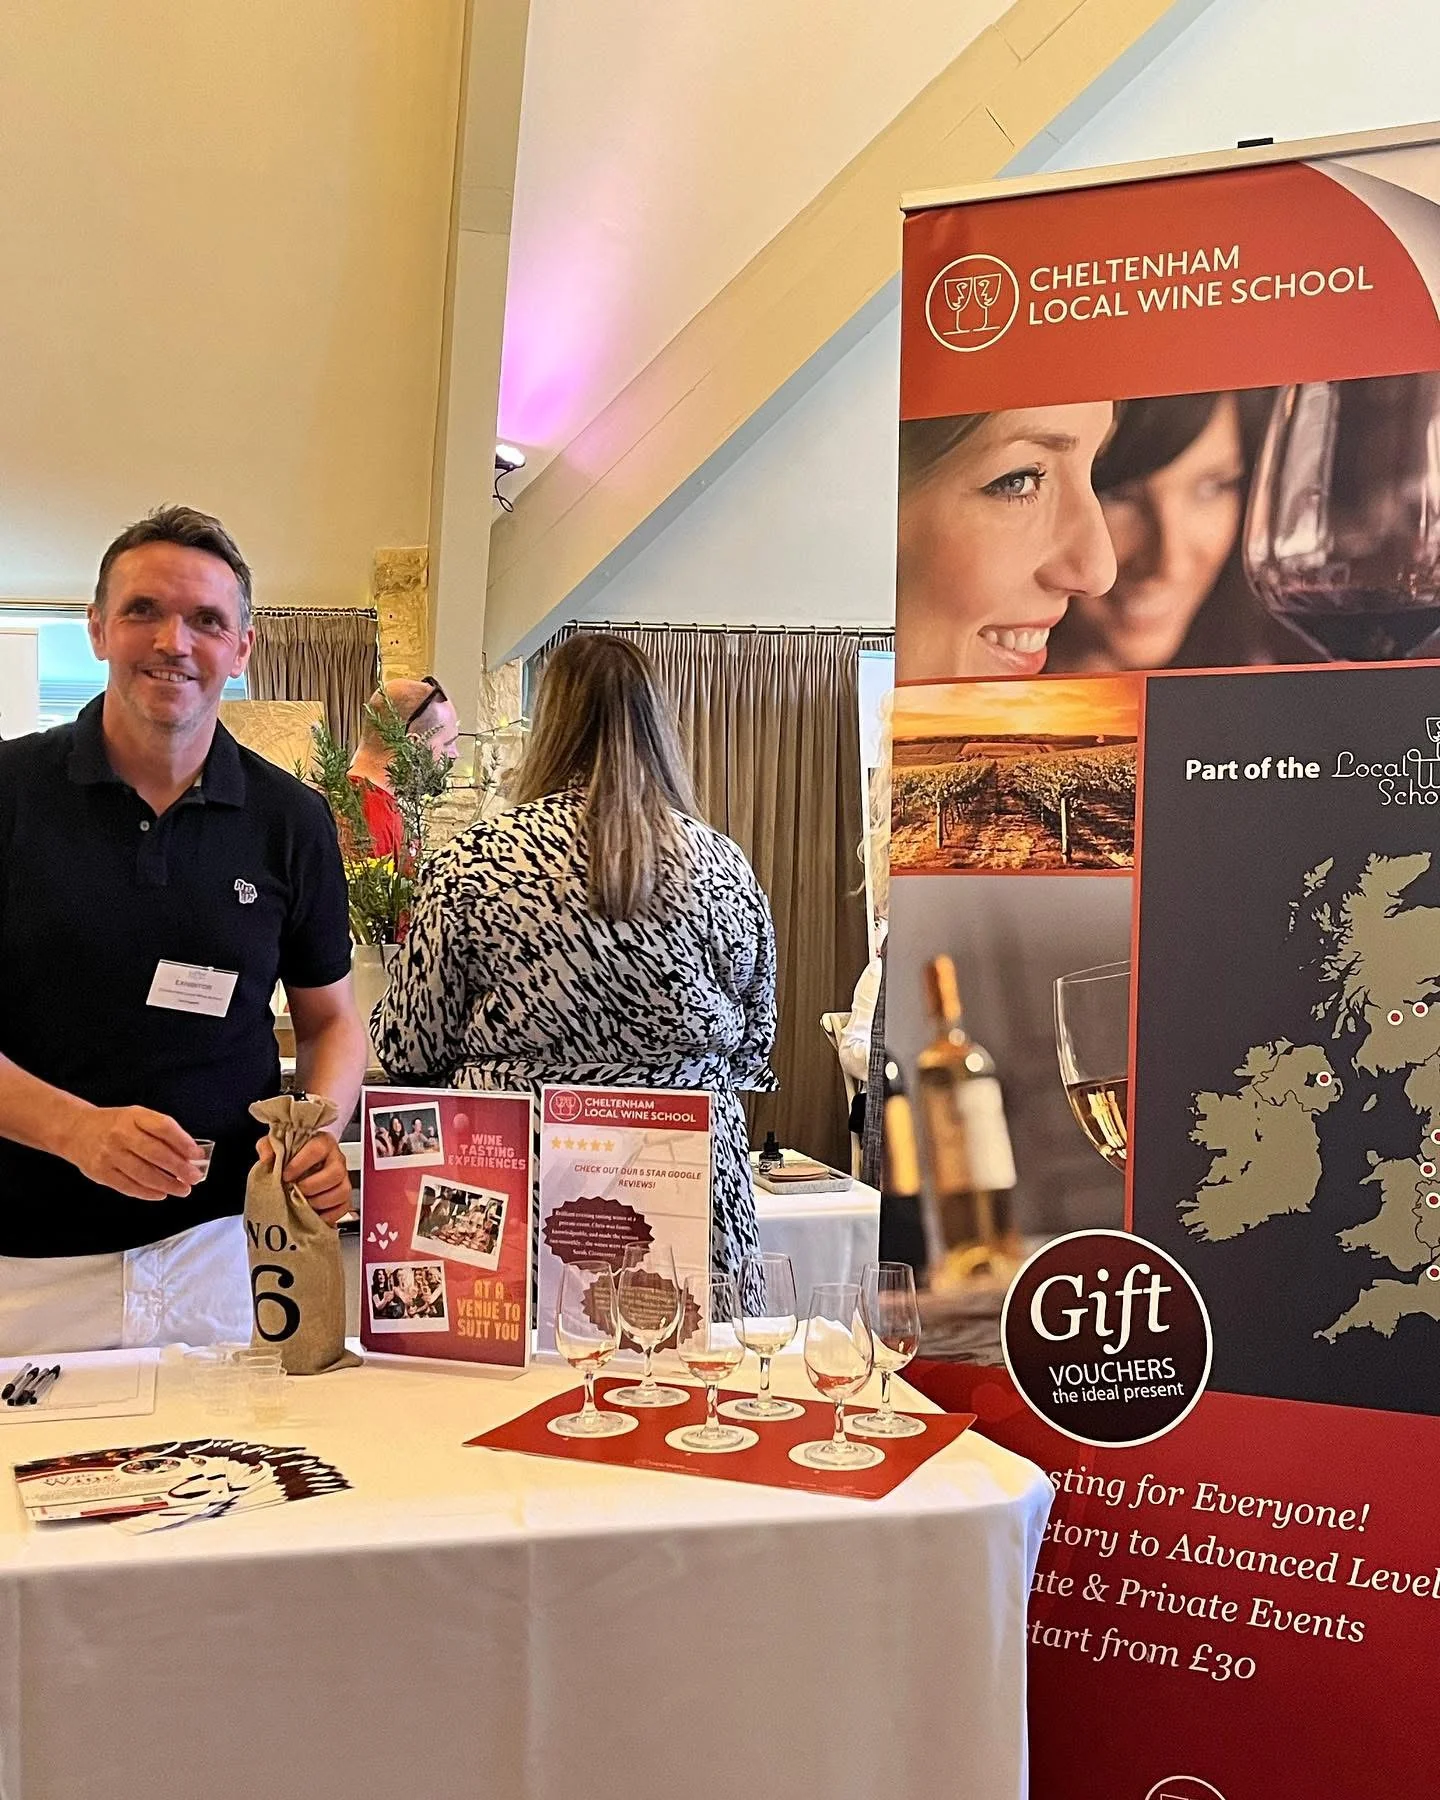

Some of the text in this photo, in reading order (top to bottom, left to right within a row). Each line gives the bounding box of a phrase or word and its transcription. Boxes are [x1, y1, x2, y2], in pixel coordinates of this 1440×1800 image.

[1028, 244, 1240, 293] CHELTENHAM
[1028, 265, 1373, 326] LOCAL WINE SCHOOL
[1186, 756, 1320, 781] Part of the
[1331, 751, 1409, 778] Local
[584, 1097, 655, 1110] CHELTENHAM
[584, 1108, 697, 1123] LOCAL WINE SCHOOL
[459, 1144, 515, 1158] TASTING
[471, 1133, 503, 1146] WINE
[447, 1154, 526, 1170] EXPERIENCES
[574, 1164, 601, 1174] CHECK
[602, 1166, 619, 1175] OUT
[620, 1167, 638, 1176] OUR
[646, 1169, 667, 1178] STAR
[667, 1170, 702, 1180] GOOGLE
[618, 1179, 656, 1189] REVIEWS!
[247, 1220, 297, 1252] NO.
[474, 1279, 504, 1300] AT A
[251, 1264, 300, 1342] 6
[456, 1297, 520, 1322] VENUE TO
[1030, 1263, 1172, 1355] Gift
[457, 1317, 520, 1341] SUIT YOU
[1048, 1357, 1176, 1387] VOUCHERS
[1052, 1382, 1185, 1404] the ideal present
[1046, 1465, 1371, 1533] sting for Everyone!
[1130, 1530, 1160, 1558] to
[1166, 1534, 1338, 1584] Advanced
[1082, 1573, 1110, 1603] &
[1116, 1578, 1239, 1623] Private
[1247, 1597, 1366, 1643] Events
[1027, 1619, 1257, 1682] tart from £30
